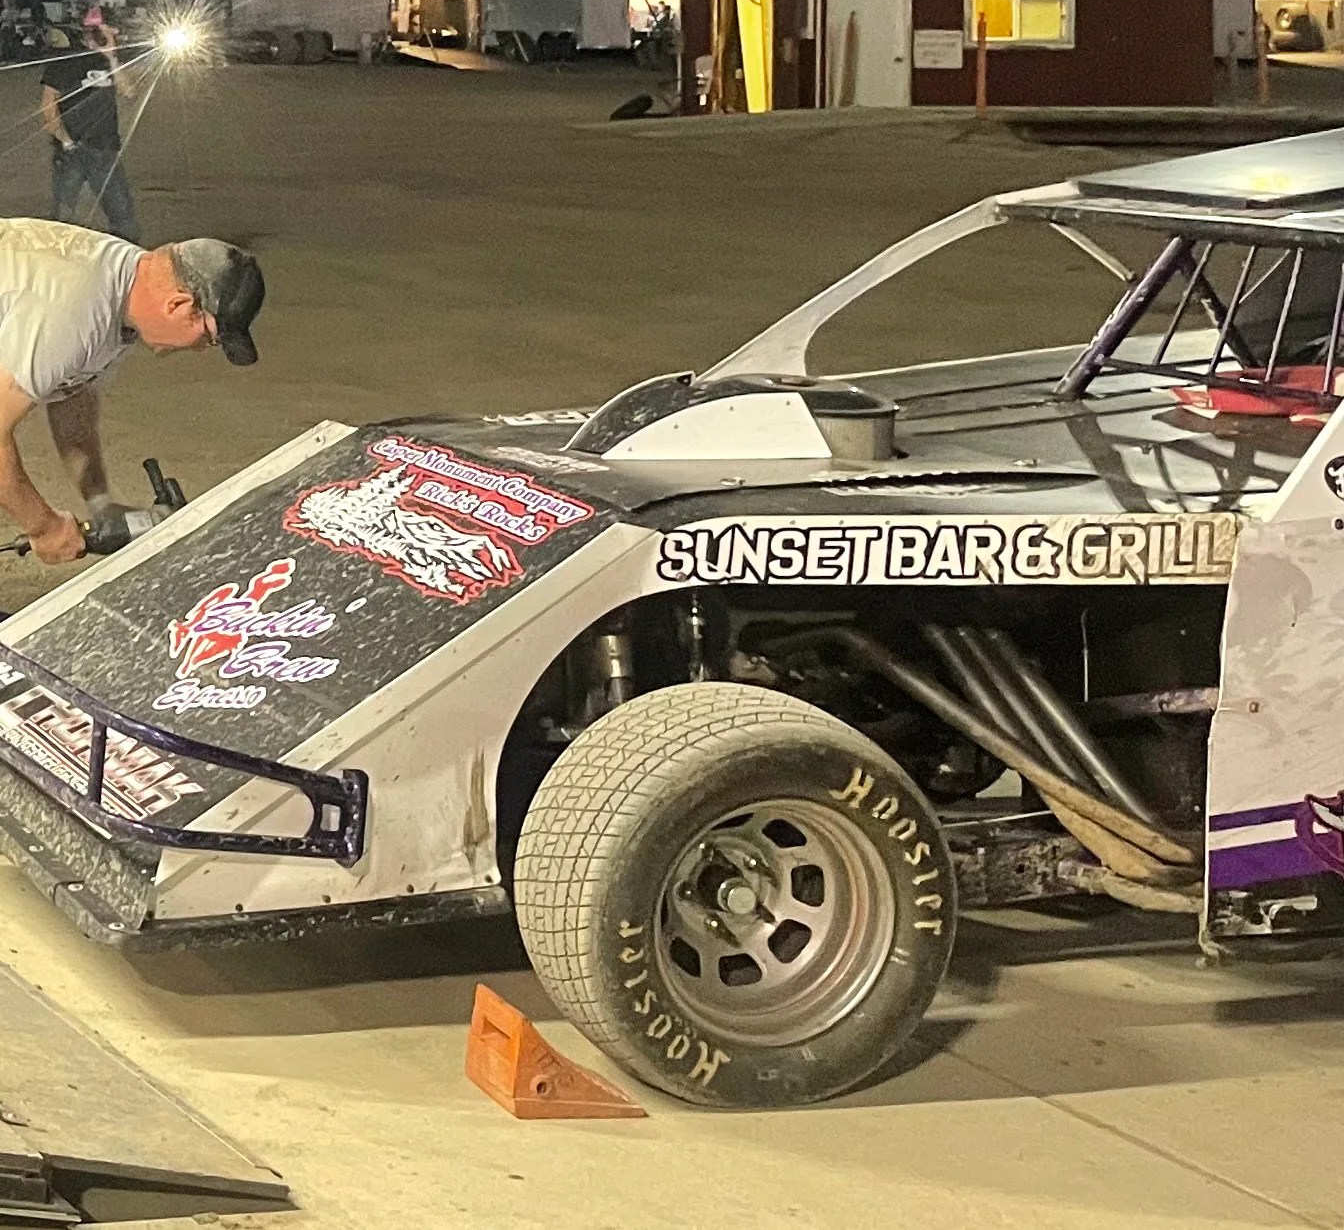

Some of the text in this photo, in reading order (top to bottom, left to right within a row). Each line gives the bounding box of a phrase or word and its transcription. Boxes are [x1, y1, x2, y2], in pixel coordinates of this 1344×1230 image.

[373, 438, 424, 466] Casper
[419, 449, 503, 489] Monument
[499, 475, 589, 521] Company
[472, 501, 550, 542] Rocks
[658, 522, 1236, 586] SUNSET BAR & GRILL
[827, 767, 944, 936] Hoosier
[618, 920, 732, 1088] Hoosier
